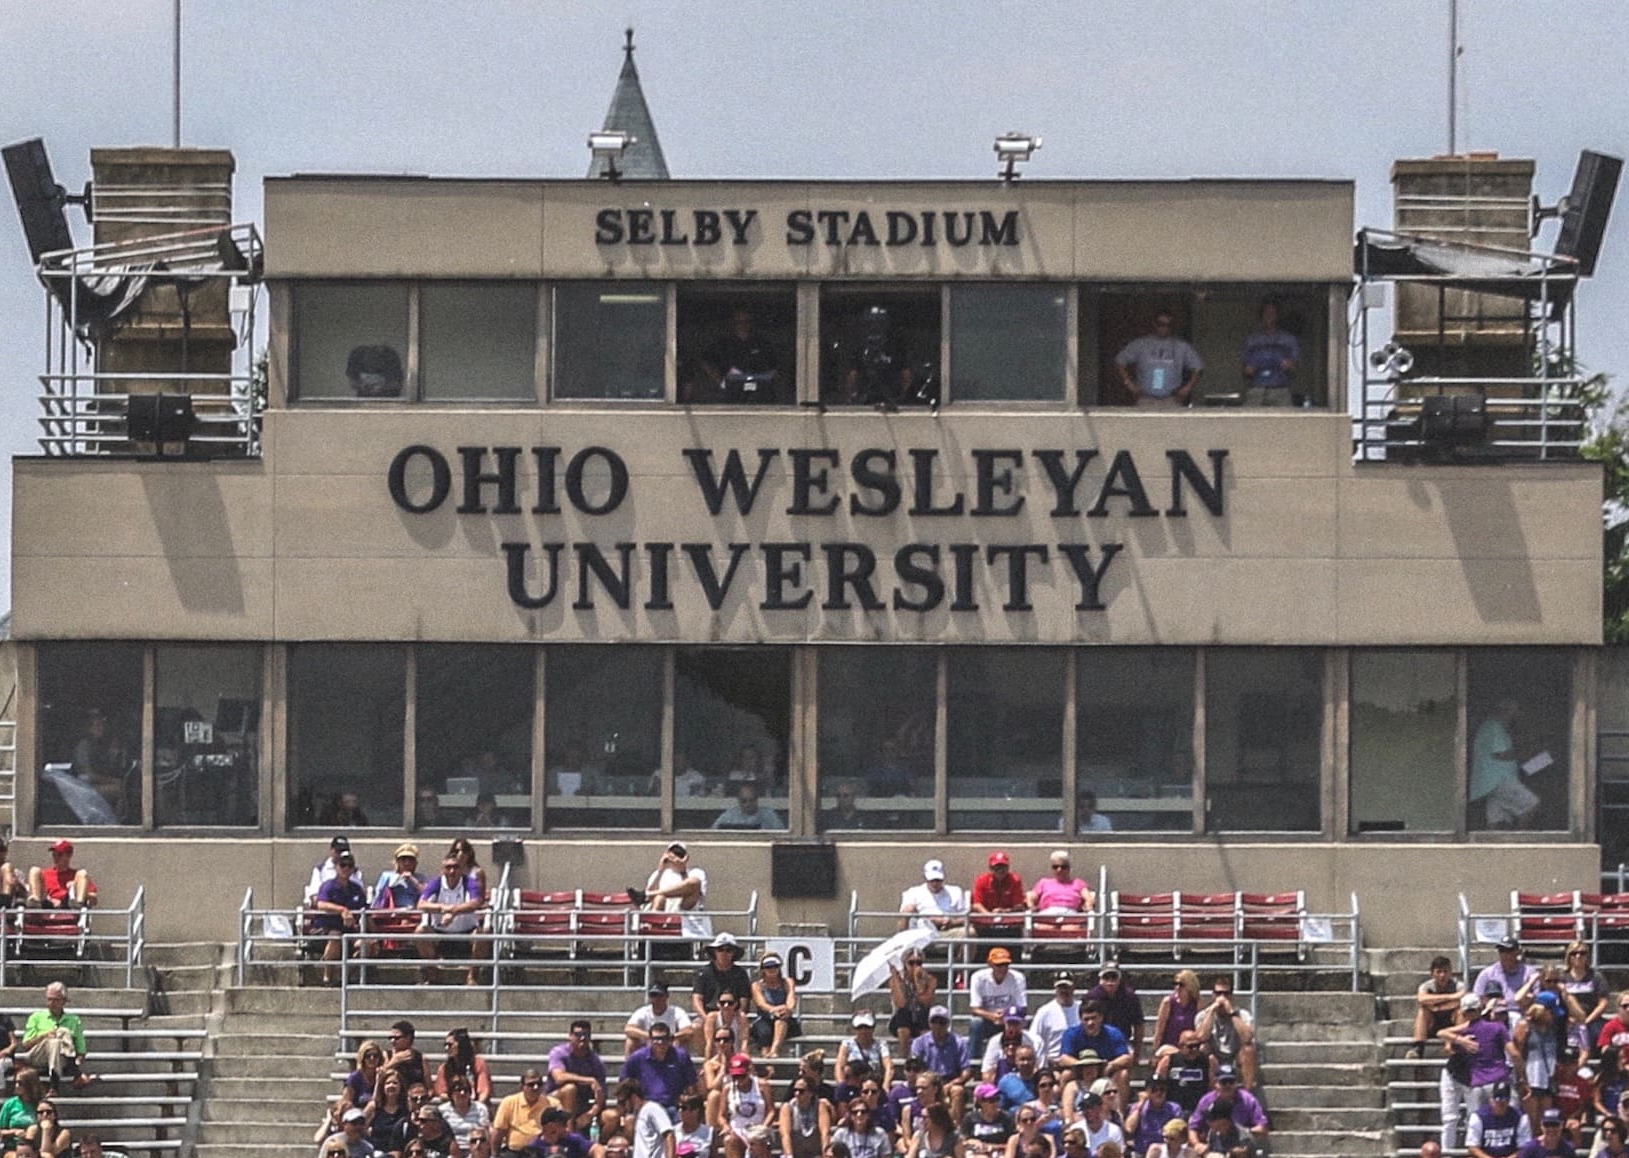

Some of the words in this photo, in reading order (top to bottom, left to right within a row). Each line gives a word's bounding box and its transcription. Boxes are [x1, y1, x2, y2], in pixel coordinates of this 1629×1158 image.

[595, 209, 757, 245] SELBY
[786, 210, 1020, 247] STADIUM
[387, 445, 629, 515] OHIO
[683, 448, 1230, 517] WESLEYAN
[501, 543, 1123, 612] UNIVERSITY
[788, 945, 812, 986] C
